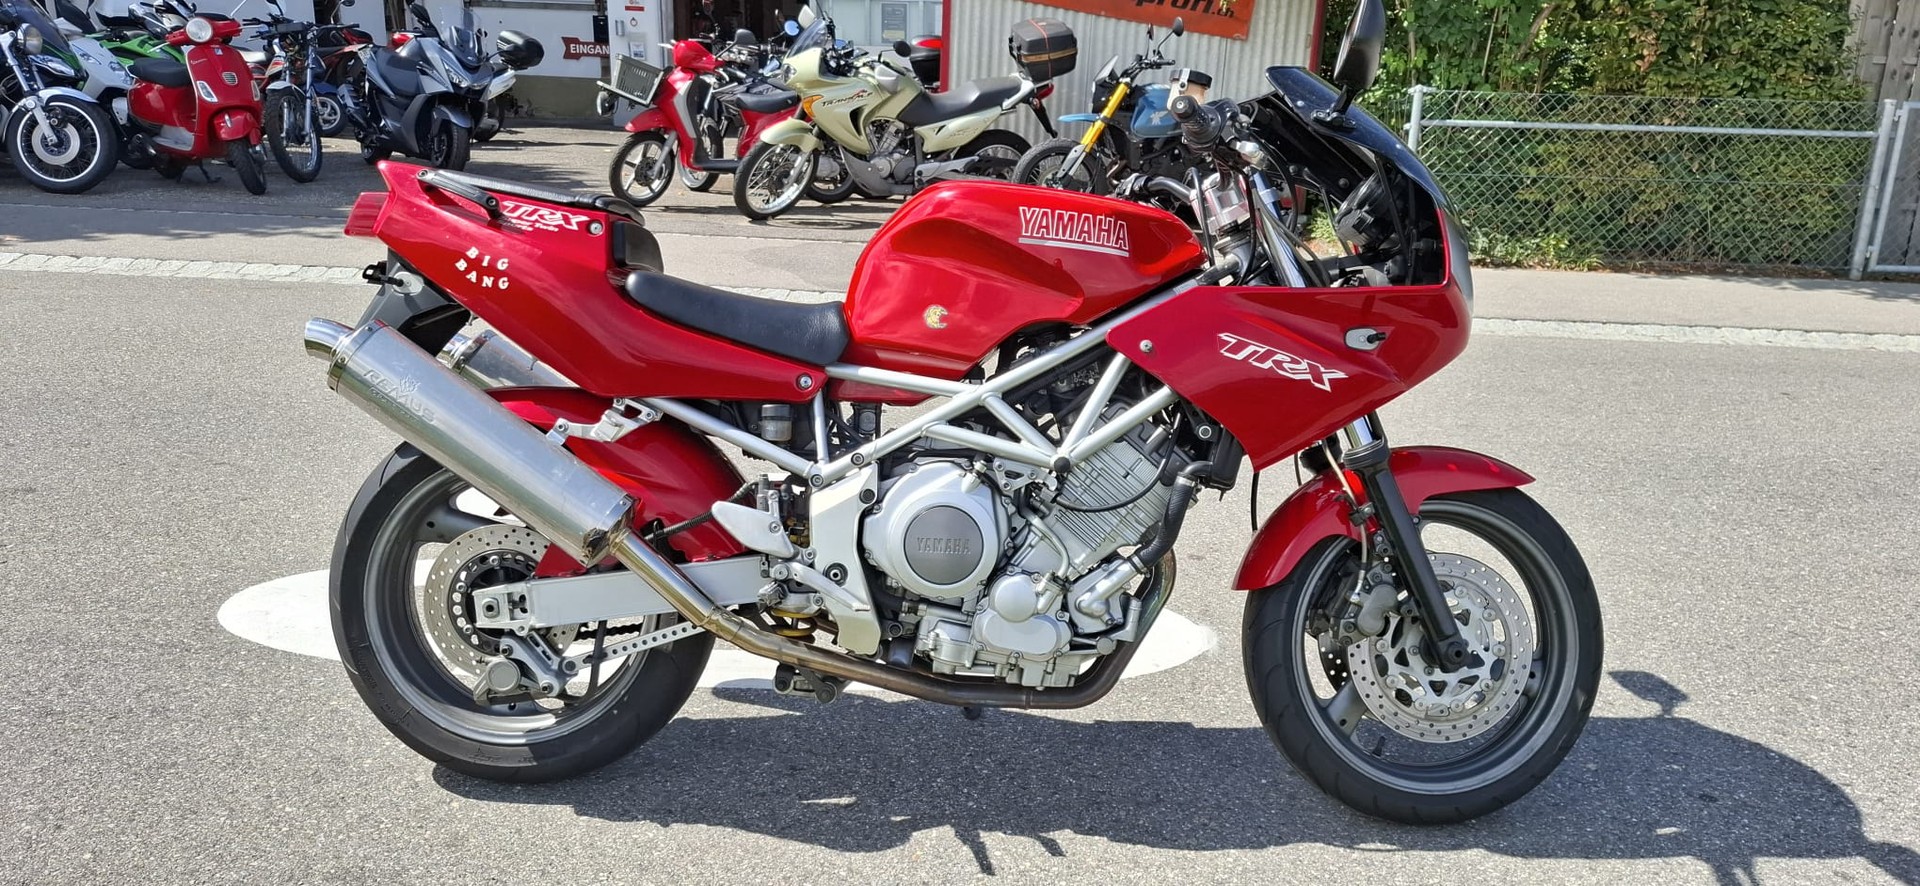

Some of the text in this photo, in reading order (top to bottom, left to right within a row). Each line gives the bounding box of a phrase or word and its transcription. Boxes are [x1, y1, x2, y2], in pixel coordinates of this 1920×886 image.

[569, 43, 610, 55] EINGAN
[502, 200, 591, 231] TRX
[1018, 206, 1129, 250] YAMAHA
[454, 258, 509, 290] BANG
[465, 246, 509, 271] BIG
[1217, 332, 1349, 392] TRX
[363, 369, 436, 424] REMUS
[916, 537, 971, 555] YAMAHA
